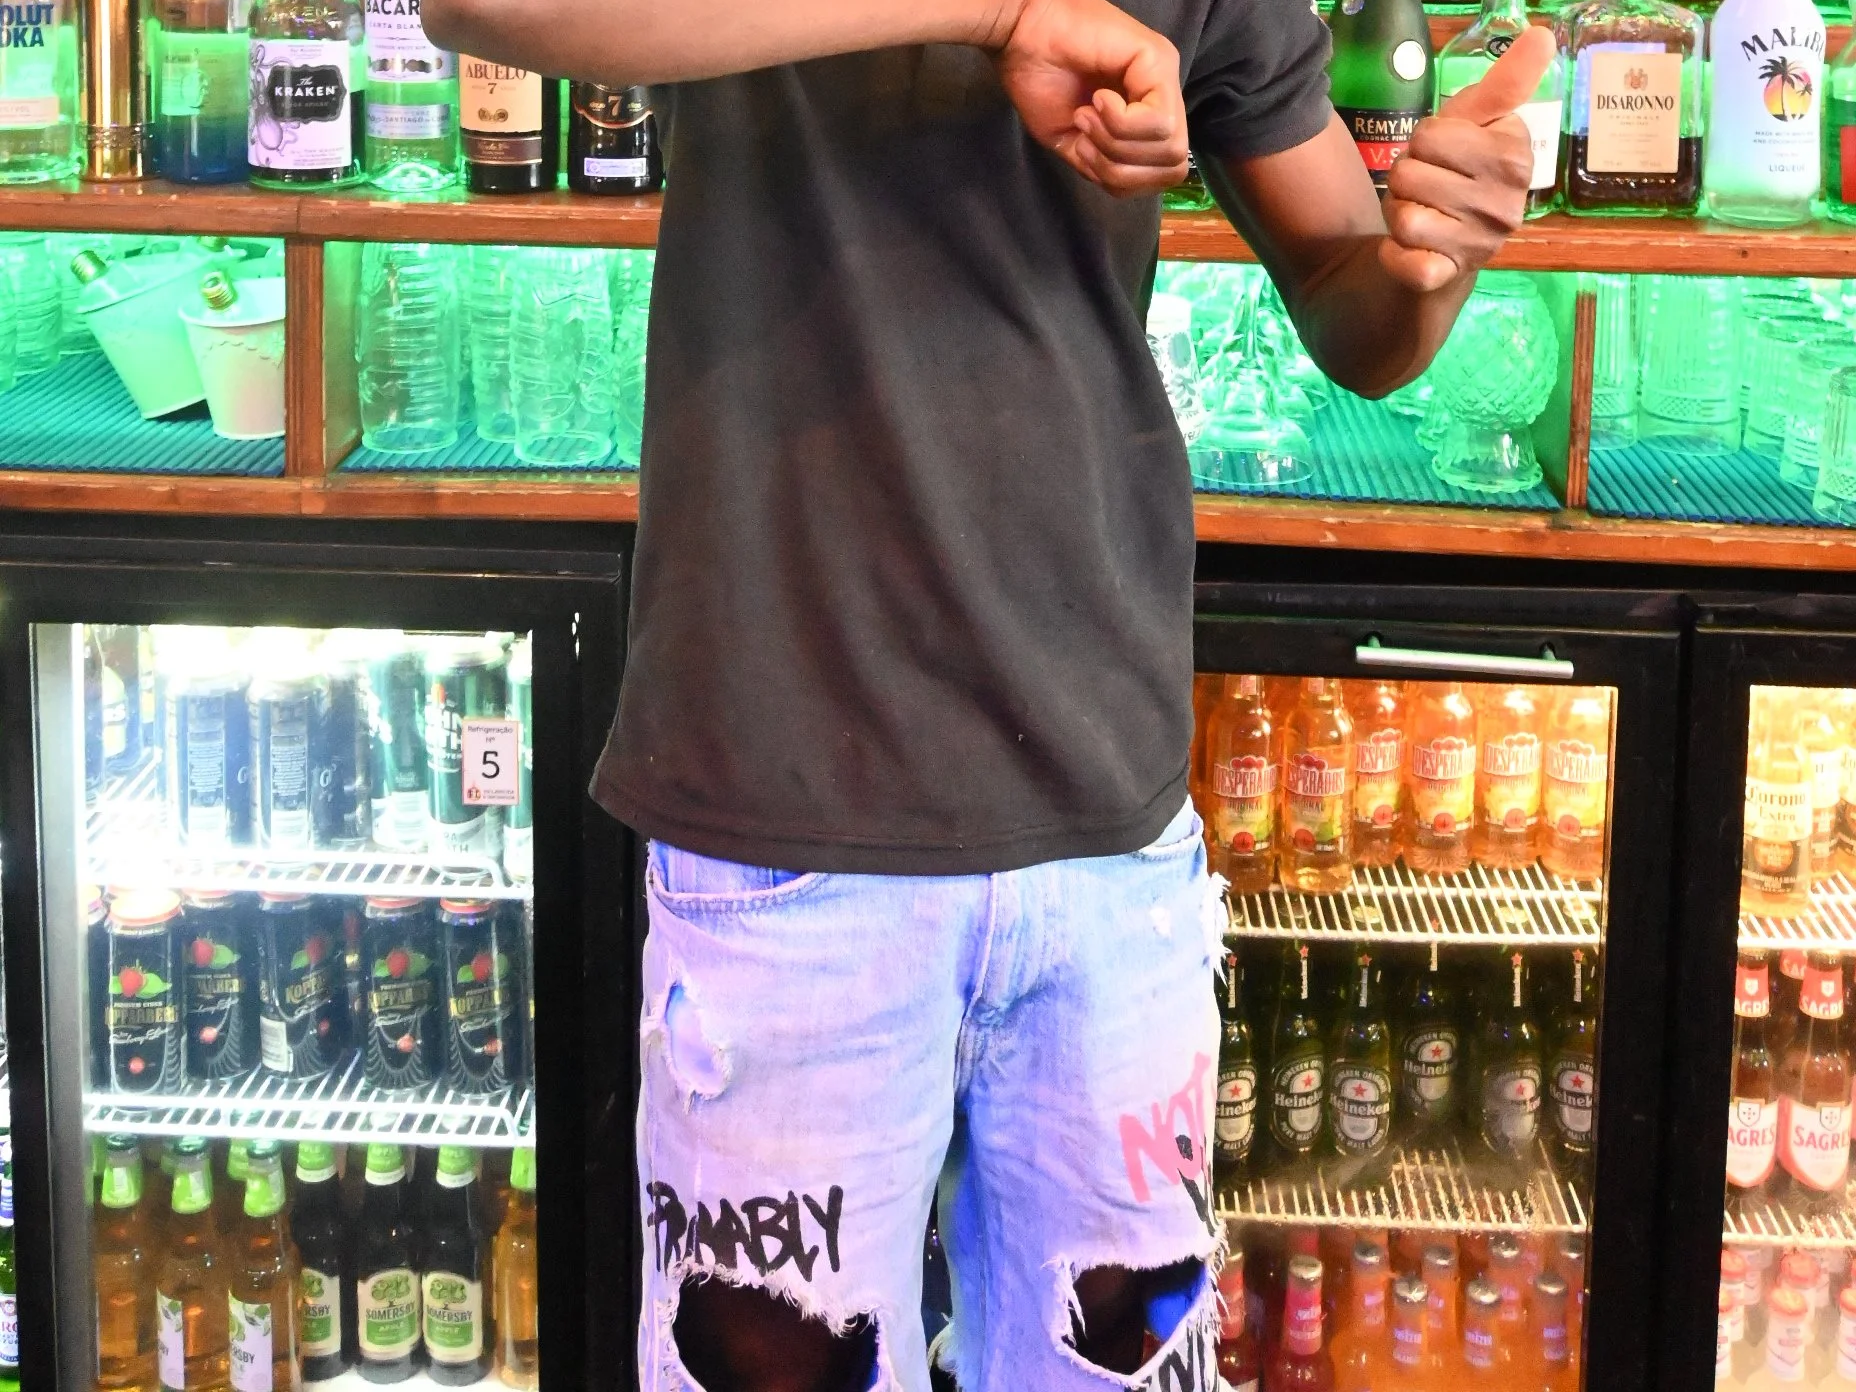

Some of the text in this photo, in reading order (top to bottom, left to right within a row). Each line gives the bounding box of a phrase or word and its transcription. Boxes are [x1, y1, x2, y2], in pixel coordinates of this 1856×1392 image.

[465, 62, 527, 81] ABUELO
[275, 86, 336, 97] KRAKEN
[487, 83, 498, 95] 7
[607, 95, 623, 117] 7
[1596, 94, 1675, 112] DISARONNO
[481, 750, 500, 779] 5
